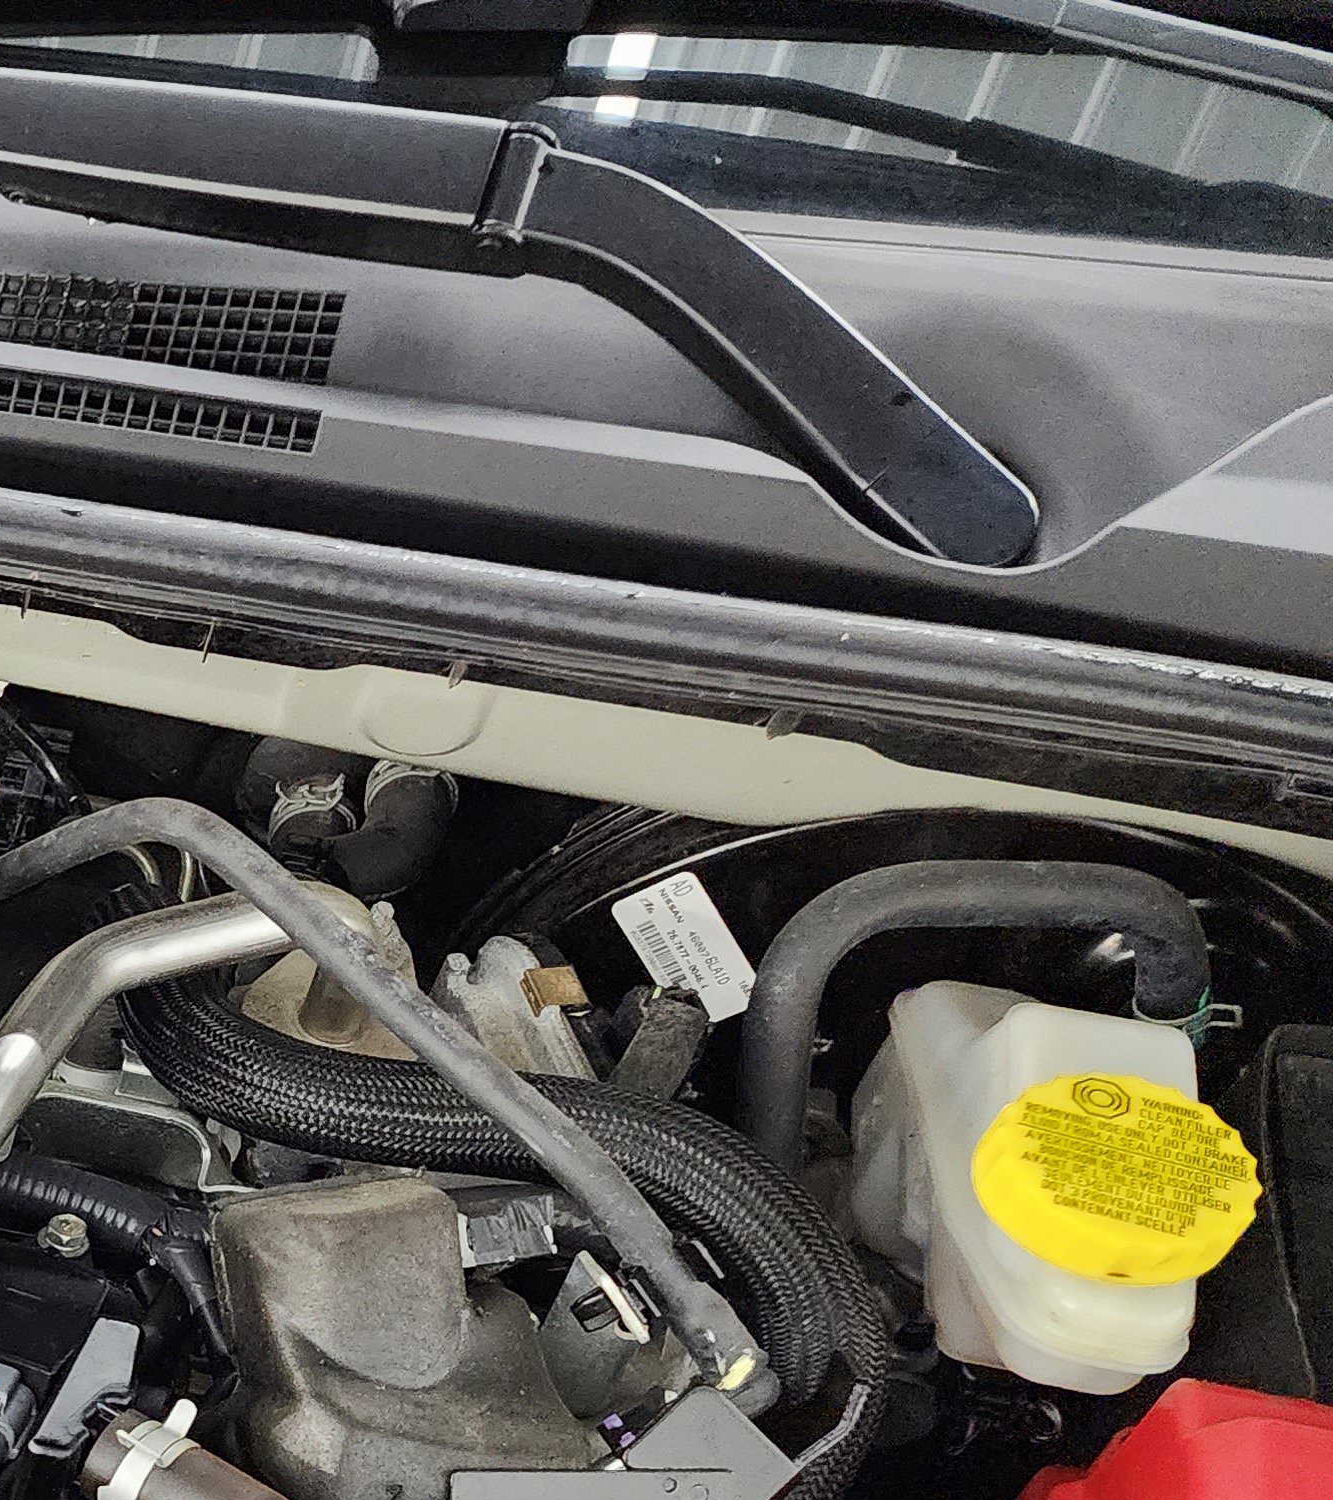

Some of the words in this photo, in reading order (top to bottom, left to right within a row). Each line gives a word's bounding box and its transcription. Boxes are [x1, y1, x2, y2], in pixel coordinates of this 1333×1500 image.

[658, 887, 684, 923] NISSAN
[1063, 1124, 1103, 1140] FROM
[1104, 1133, 1115, 1143] A
[1117, 1138, 1171, 1157] SEALED
[1138, 1110, 1186, 1127] CLEAN
[1185, 1120, 1232, 1138] FILLER
[1170, 1129, 1221, 1147] BEFORE
[1096, 1120, 1120, 1133] USE
[1123, 1128, 1158, 1142] ONLY
[1162, 1138, 1188, 1151] DOT
[1190, 1144, 1200, 1154] 3
[1201, 1148, 1248, 1166] BRAKE
[1021, 1151, 1067, 1169] AVANT
[1069, 1163, 1089, 1175] DE
[1170, 1190, 1233, 1212] UTILISER
[1099, 1159, 1120, 1172] DE
[1121, 1167, 1216, 1194] REMPLISSAGE
[1141, 1160, 1211, 1183] NETTOYER
[1214, 1178, 1232, 1191] LE
[1039, 1178, 1068, 1193] DOT
[1078, 1190, 1163, 1217] PROVENANT
[1163, 1211, 1197, 1228] D'UN
[1051, 1196, 1132, 1221] CONTENANT
[1124, 1188, 1142, 1200] DU
[1143, 1194, 1198, 1214] LIQUIDE
